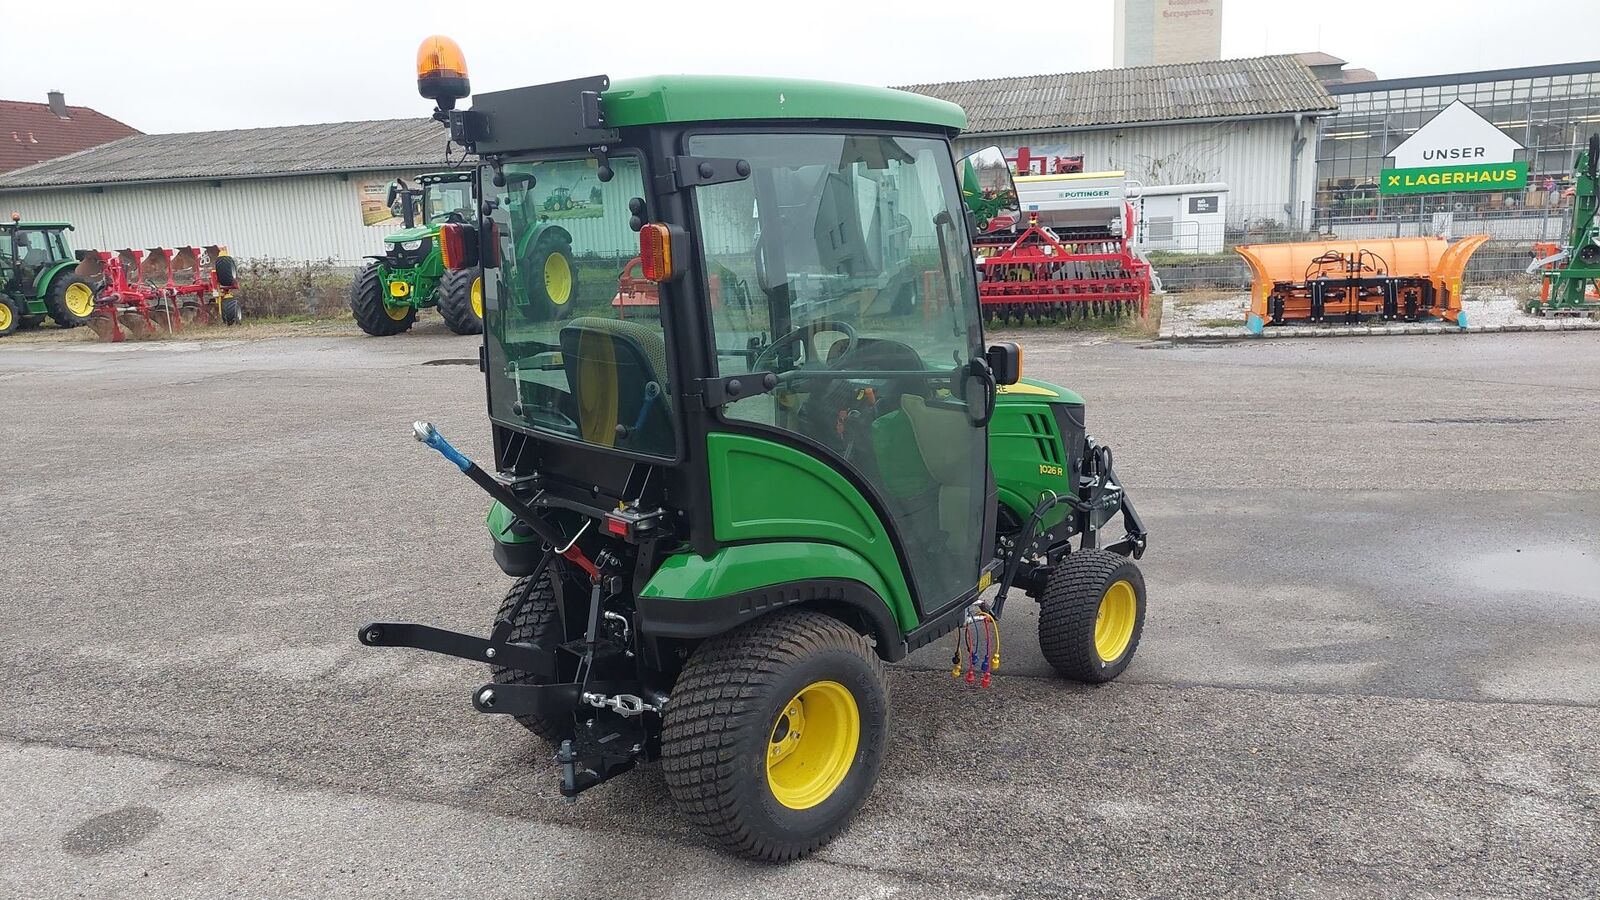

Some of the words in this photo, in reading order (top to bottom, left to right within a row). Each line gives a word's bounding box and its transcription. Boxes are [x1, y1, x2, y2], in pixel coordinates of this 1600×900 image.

[1423, 147, 1485, 160] UNSER
[1405, 170, 1517, 186] LAGERHAUS
[1039, 464, 1057, 475] 1026
